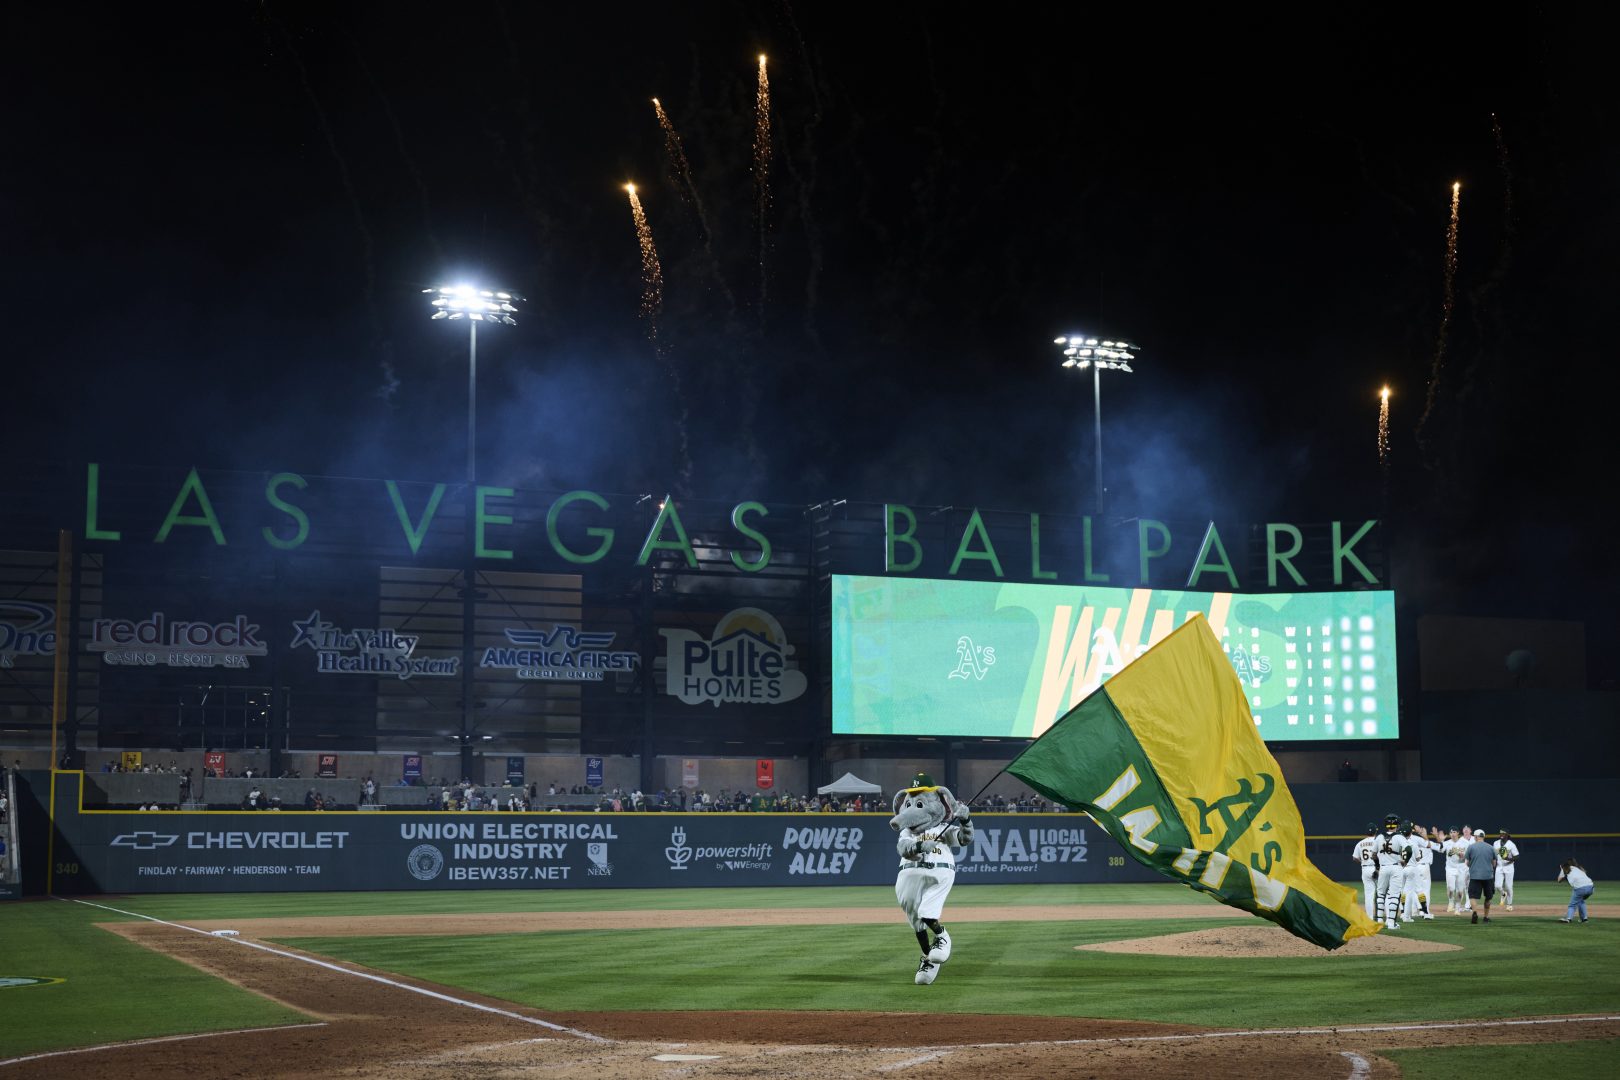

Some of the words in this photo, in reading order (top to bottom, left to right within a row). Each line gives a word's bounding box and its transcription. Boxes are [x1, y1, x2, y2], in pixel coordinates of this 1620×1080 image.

[85, 462, 311, 551] LAS
[385, 480, 772, 573] VEGAS
[883, 503, 1380, 588] BALLPARK
[95, 613, 161, 645] red
[173, 616, 262, 648] rock
[320, 630, 354, 649] The
[352, 629, 417, 657] Valley
[105, 651, 156, 664] CASINO
[168, 651, 215, 666] RESORT
[225, 653, 248, 666] SPA
[319, 652, 393, 672] Health
[394, 656, 455, 679] System
[482, 650, 574, 668] AMERICA
[578, 652, 638, 669] FIRST
[684, 638, 783, 679] Pulte
[519, 669, 562, 678] CREDIT
[568, 671, 604, 679] UNION
[684, 677, 781, 699] HOMES
[187, 831, 349, 849] CHEVROLET
[400, 823, 475, 840] UNION
[483, 823, 618, 840] ELECTRICAL
[782, 827, 863, 850] POWER
[1040, 828, 1088, 845] LOCAL
[454, 843, 568, 860] INDUSTRY
[695, 843, 773, 861] powershift
[1040, 846, 1088, 863] 872
[56, 863, 79, 875] 340
[138, 866, 178, 876] FINDLAY
[185, 866, 226, 876] FAIRWAY
[233, 865, 288, 875] HENDERSON
[295, 865, 321, 875] TEAM
[716, 862, 724, 871] by
[733, 860, 771, 871] NVEnergy
[789, 851, 857, 875] ALLEY
[956, 864, 978, 873] Feel
[980, 863, 998, 873] the
[1000, 863, 1038, 873] Power!
[1108, 857, 1125, 867] 380
[448, 866, 571, 880] IBEW357.NET
[587, 867, 612, 876] NECA
